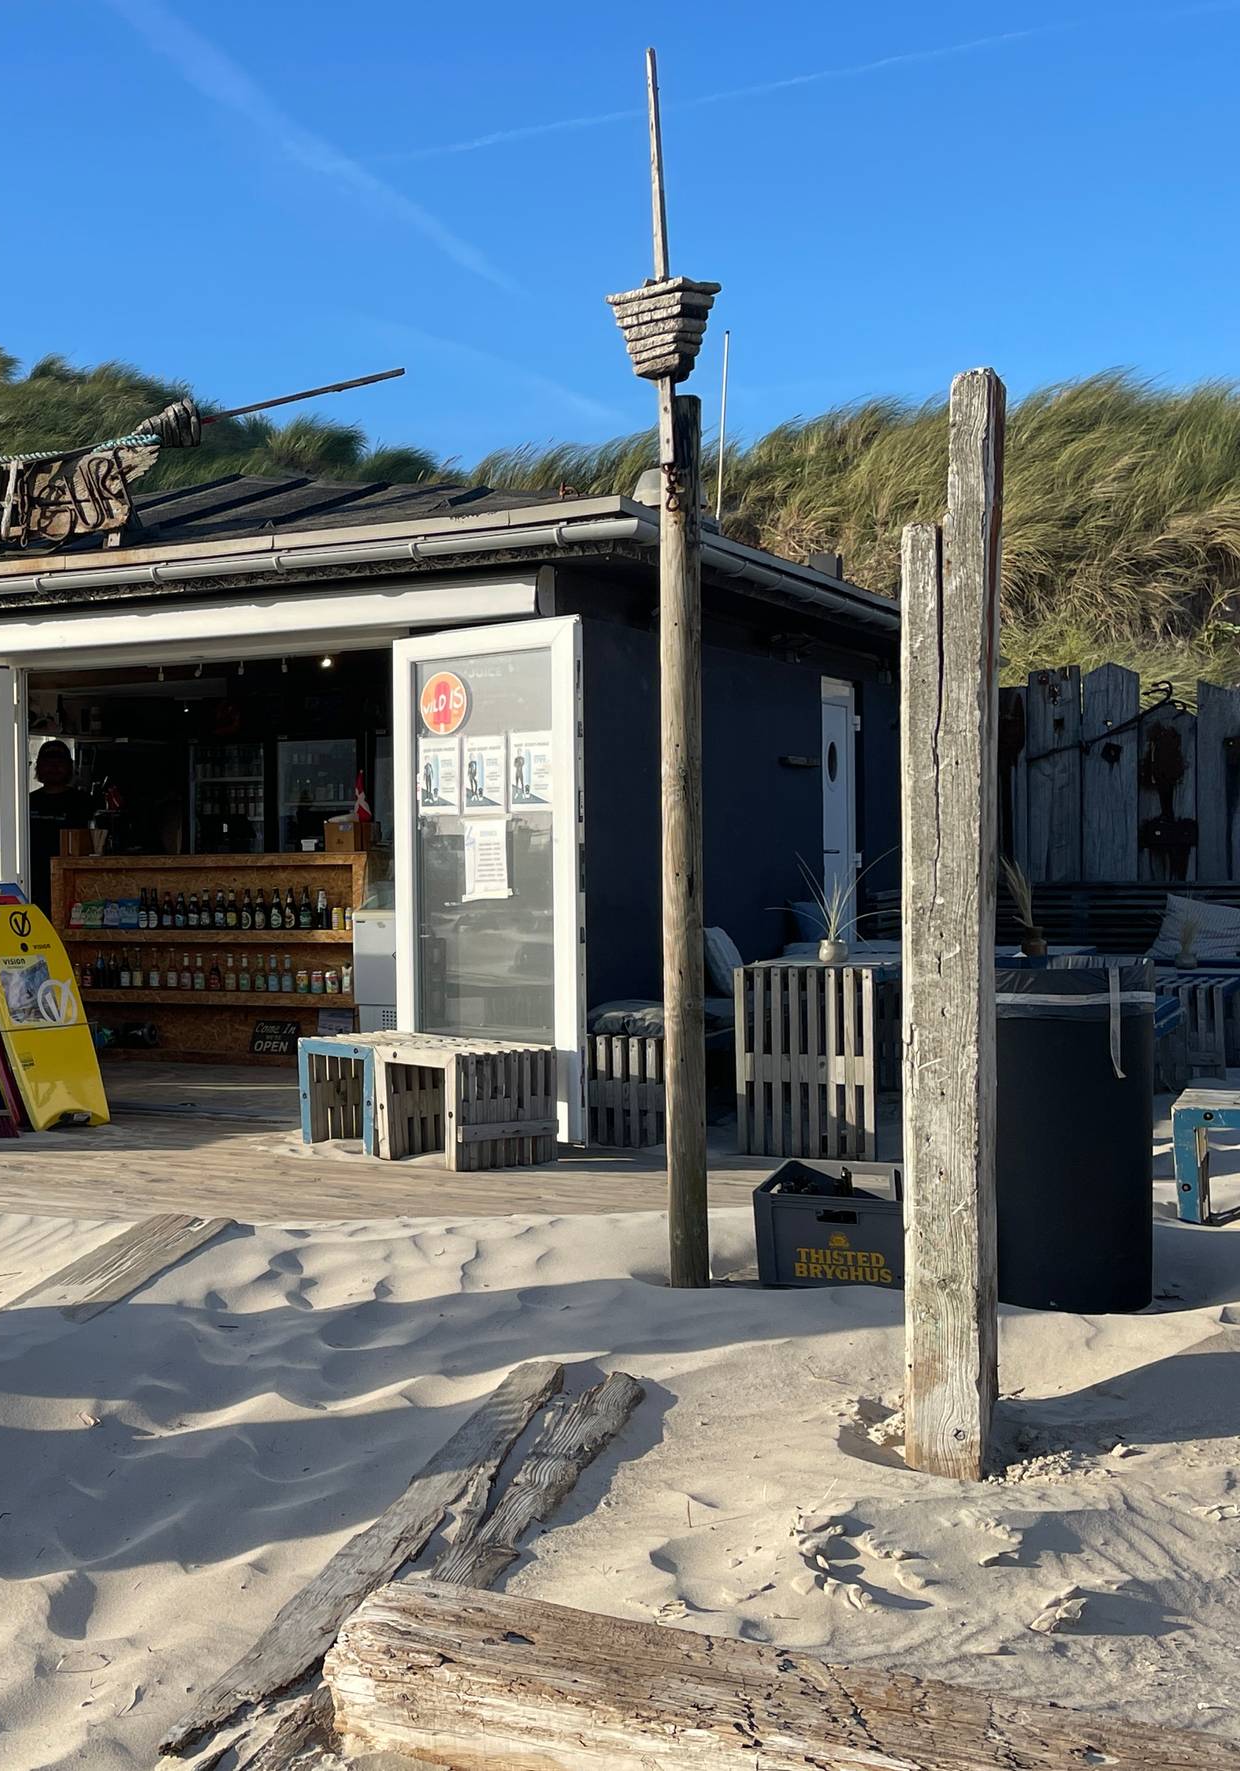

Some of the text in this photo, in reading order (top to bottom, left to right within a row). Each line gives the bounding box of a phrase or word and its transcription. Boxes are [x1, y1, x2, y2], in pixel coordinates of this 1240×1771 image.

[423, 686, 464, 714] VILD IS
[255, 1022, 297, 1034] Come In
[254, 1040, 289, 1052] OPEN
[795, 1247, 885, 1268] THISTED
[794, 1262, 893, 1283] BRYGHUS
